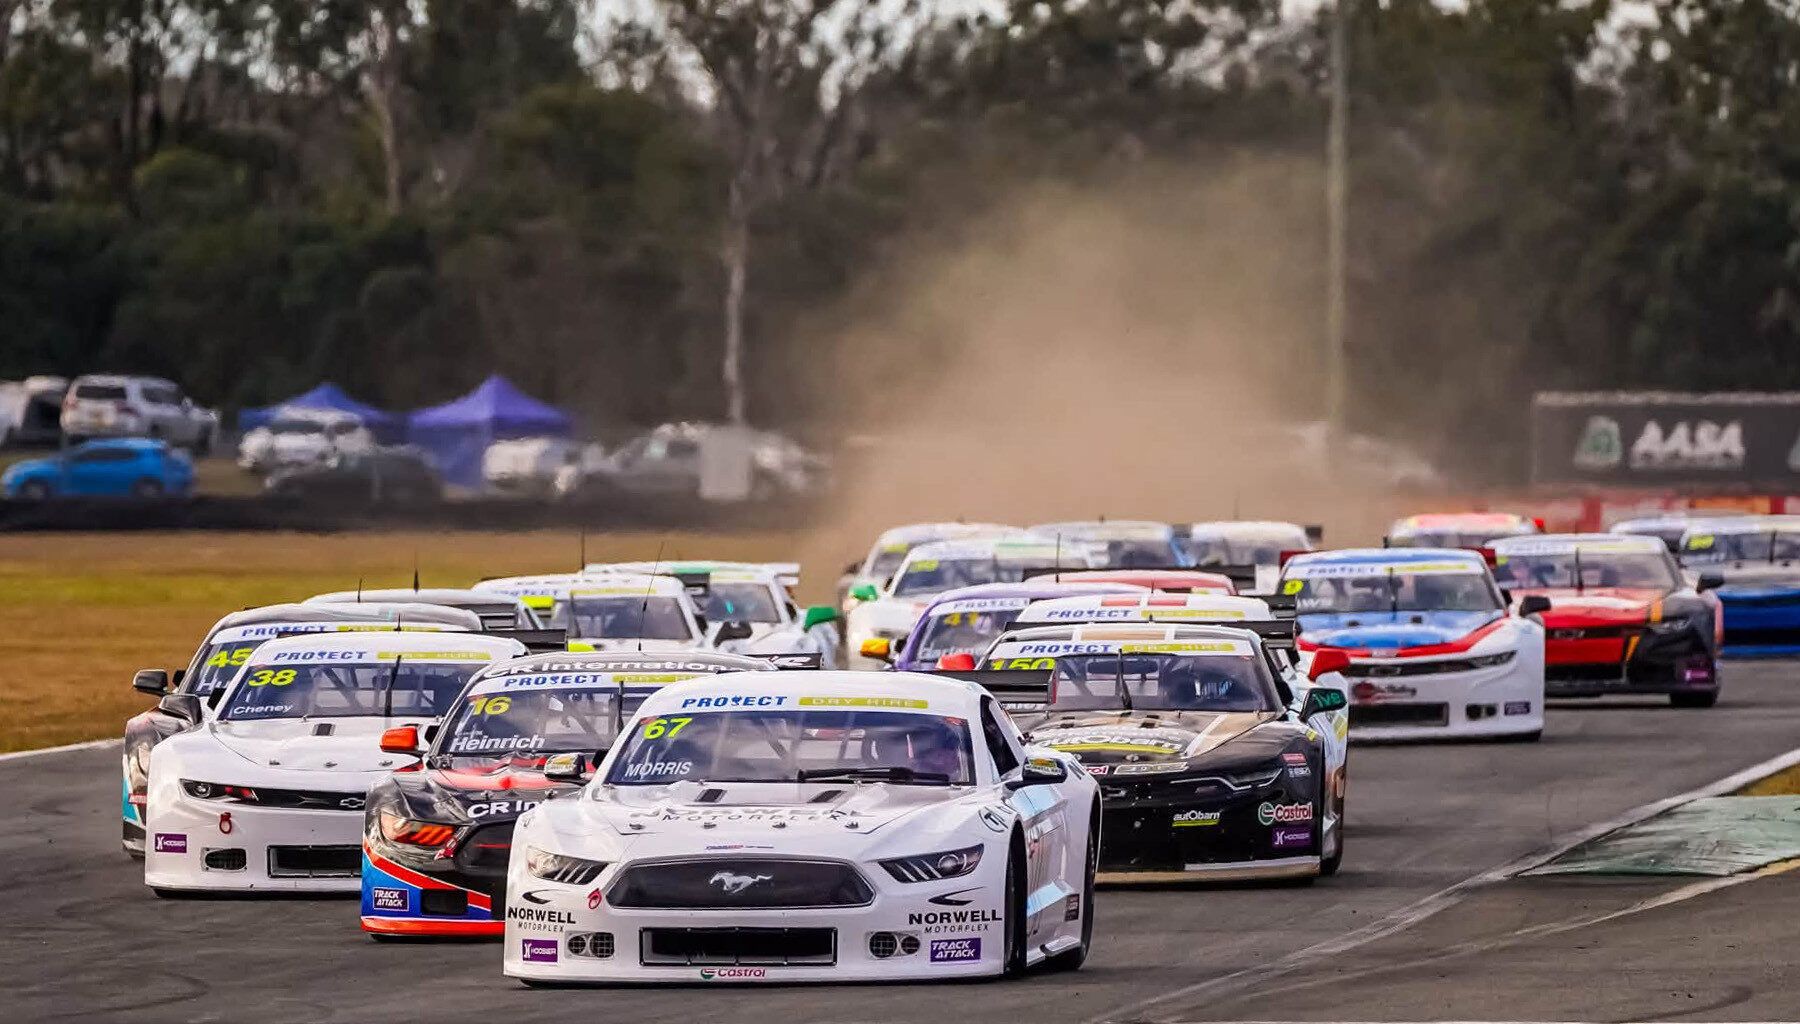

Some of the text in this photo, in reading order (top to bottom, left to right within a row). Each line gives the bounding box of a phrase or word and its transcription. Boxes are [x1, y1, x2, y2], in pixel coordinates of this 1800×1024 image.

[1629, 419, 1745, 470] AASA
[206, 648, 253, 668] 45
[248, 669, 298, 687] 38
[233, 704, 294, 715] Cheney
[472, 696, 512, 715] 16
[643, 718, 693, 739] 67
[449, 734, 546, 751] Heinrich
[624, 761, 693, 777] MORRIS
[1274, 801, 1313, 821] Castrol
[374, 889, 399, 899] TRACK
[376, 899, 403, 907] ATTACK
[508, 906, 577, 924] NORWELL
[908, 909, 1003, 925] NORWELL
[518, 922, 565, 932] MOTORPLEX
[924, 923, 989, 934] MOTORPLEX
[931, 940, 971, 950] TRACK
[934, 949, 976, 959] ATTACK
[718, 968, 766, 977] Castrol
